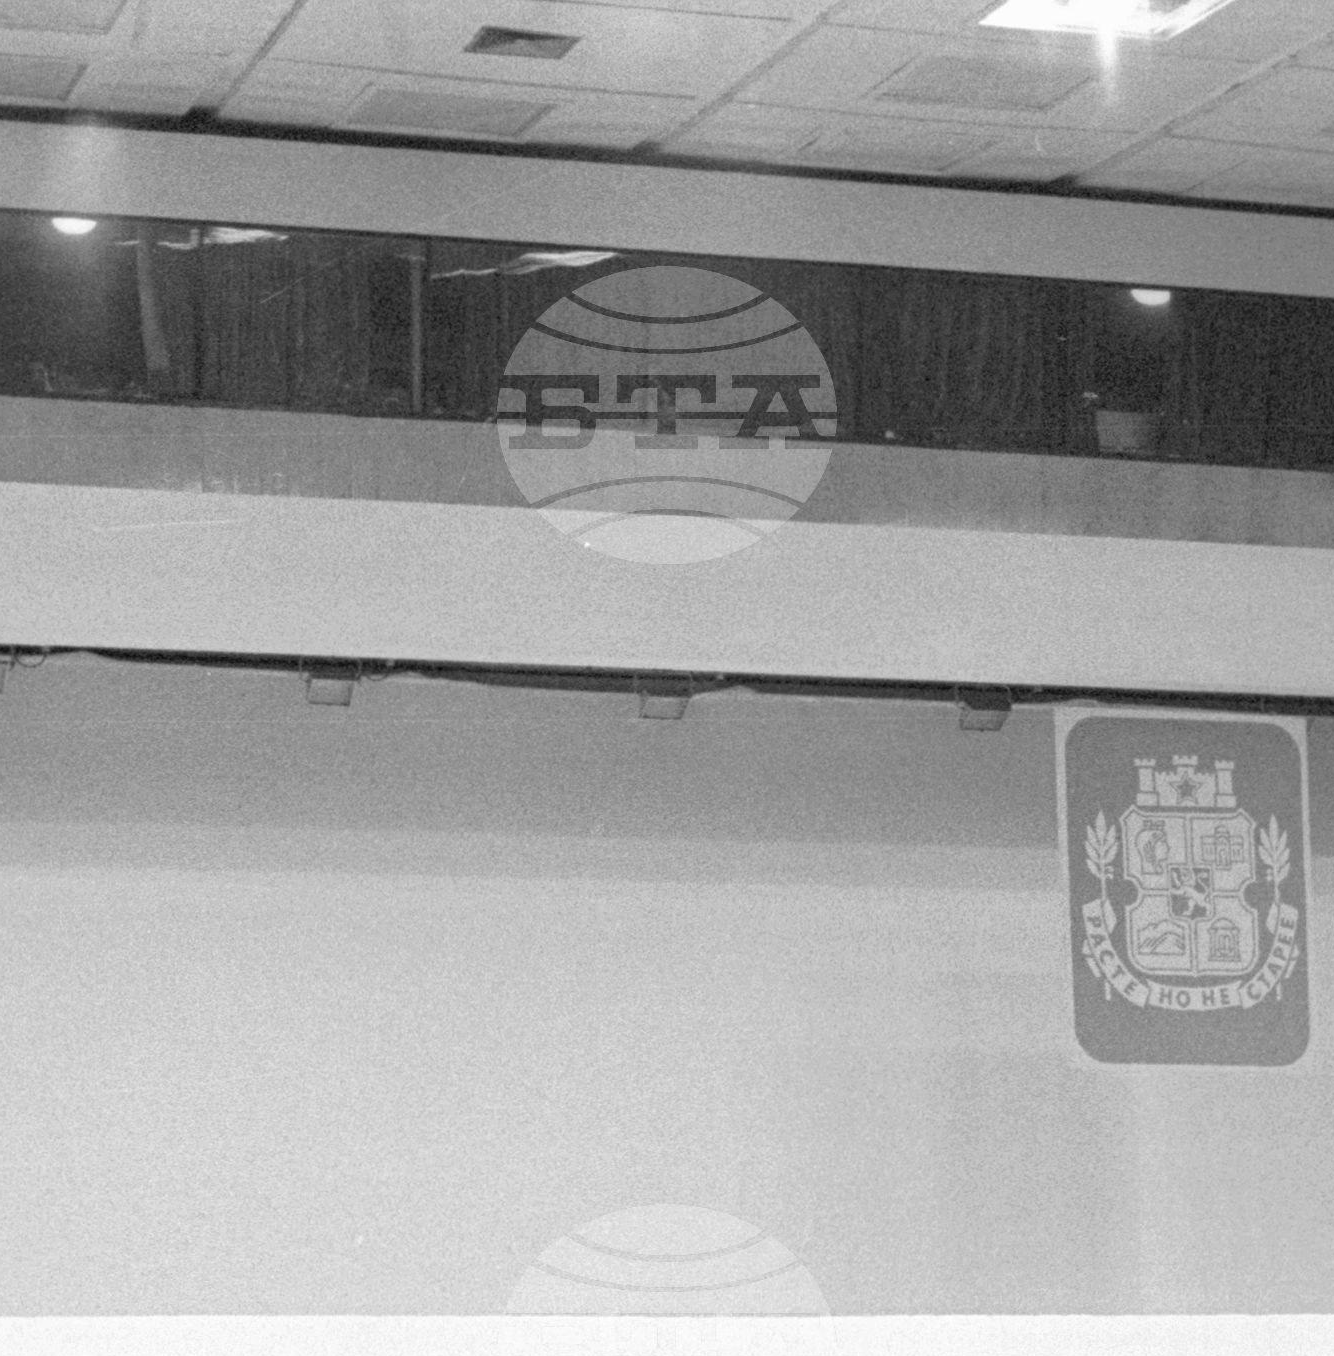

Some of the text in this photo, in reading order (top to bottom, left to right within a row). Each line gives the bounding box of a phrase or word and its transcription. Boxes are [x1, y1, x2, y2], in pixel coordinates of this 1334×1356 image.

[1087, 915, 1295, 1008] РАСТЕ НО НЕ СТАРЕЕ
